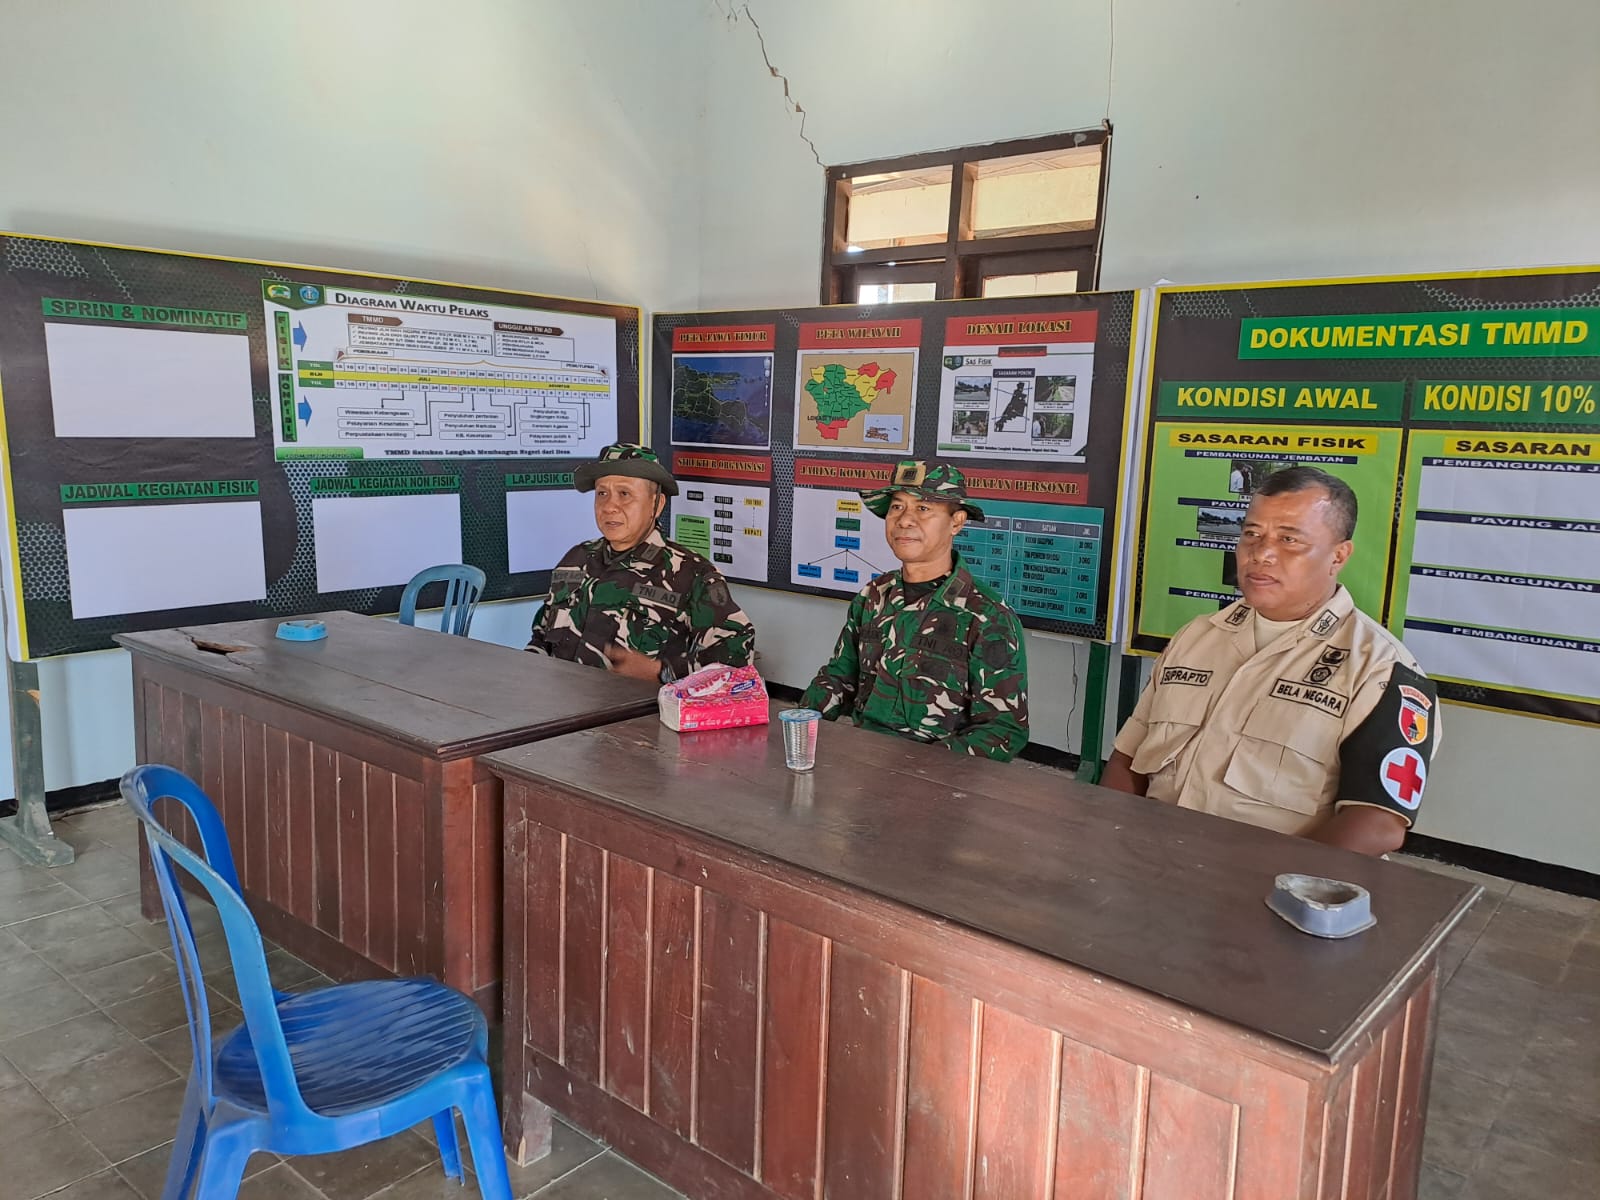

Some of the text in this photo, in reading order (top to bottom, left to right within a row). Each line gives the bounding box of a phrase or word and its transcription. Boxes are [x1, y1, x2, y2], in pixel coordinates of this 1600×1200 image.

[335, 292, 489, 318] DIAGRAM WAKTU PELAKS
[51, 300, 242, 327] SPRIN & NOMINATIF
[966, 320, 1072, 335] DENAH LOKASI
[1250, 321, 1589, 348] DOKUMENTASI TMMD
[278, 316, 289, 366] FISIK
[1177, 388, 1378, 409] KONDISI AWAL
[1423, 385, 1596, 414] KONDISI 10%
[1178, 434, 1366, 449] SASARAN FISIK
[1456, 440, 1591, 456] SASARAN
[1196, 452, 1280, 460] PEMBANGUNAN
[800, 466, 836, 476] JARING
[1432, 458, 1580, 472] PEMBANGUNAN
[314, 476, 456, 490] JADWAL KEGIATAN NON FISIK
[512, 474, 573, 484] LAPJUSIK GI
[65, 481, 255, 499] JADWAL KEGIATAN FISIK
[1470, 516, 1552, 528] PAVING
[1422, 568, 1593, 591] PEMBANGUNAN
[640, 586, 656, 598] TNI
[917, 637, 937, 649] TNI
[1452, 627, 1577, 649] PEMBANGUNAN
[1164, 668, 1208, 684] SUPRAPTO
[1277, 684, 1342, 712] BELA NEGARA
